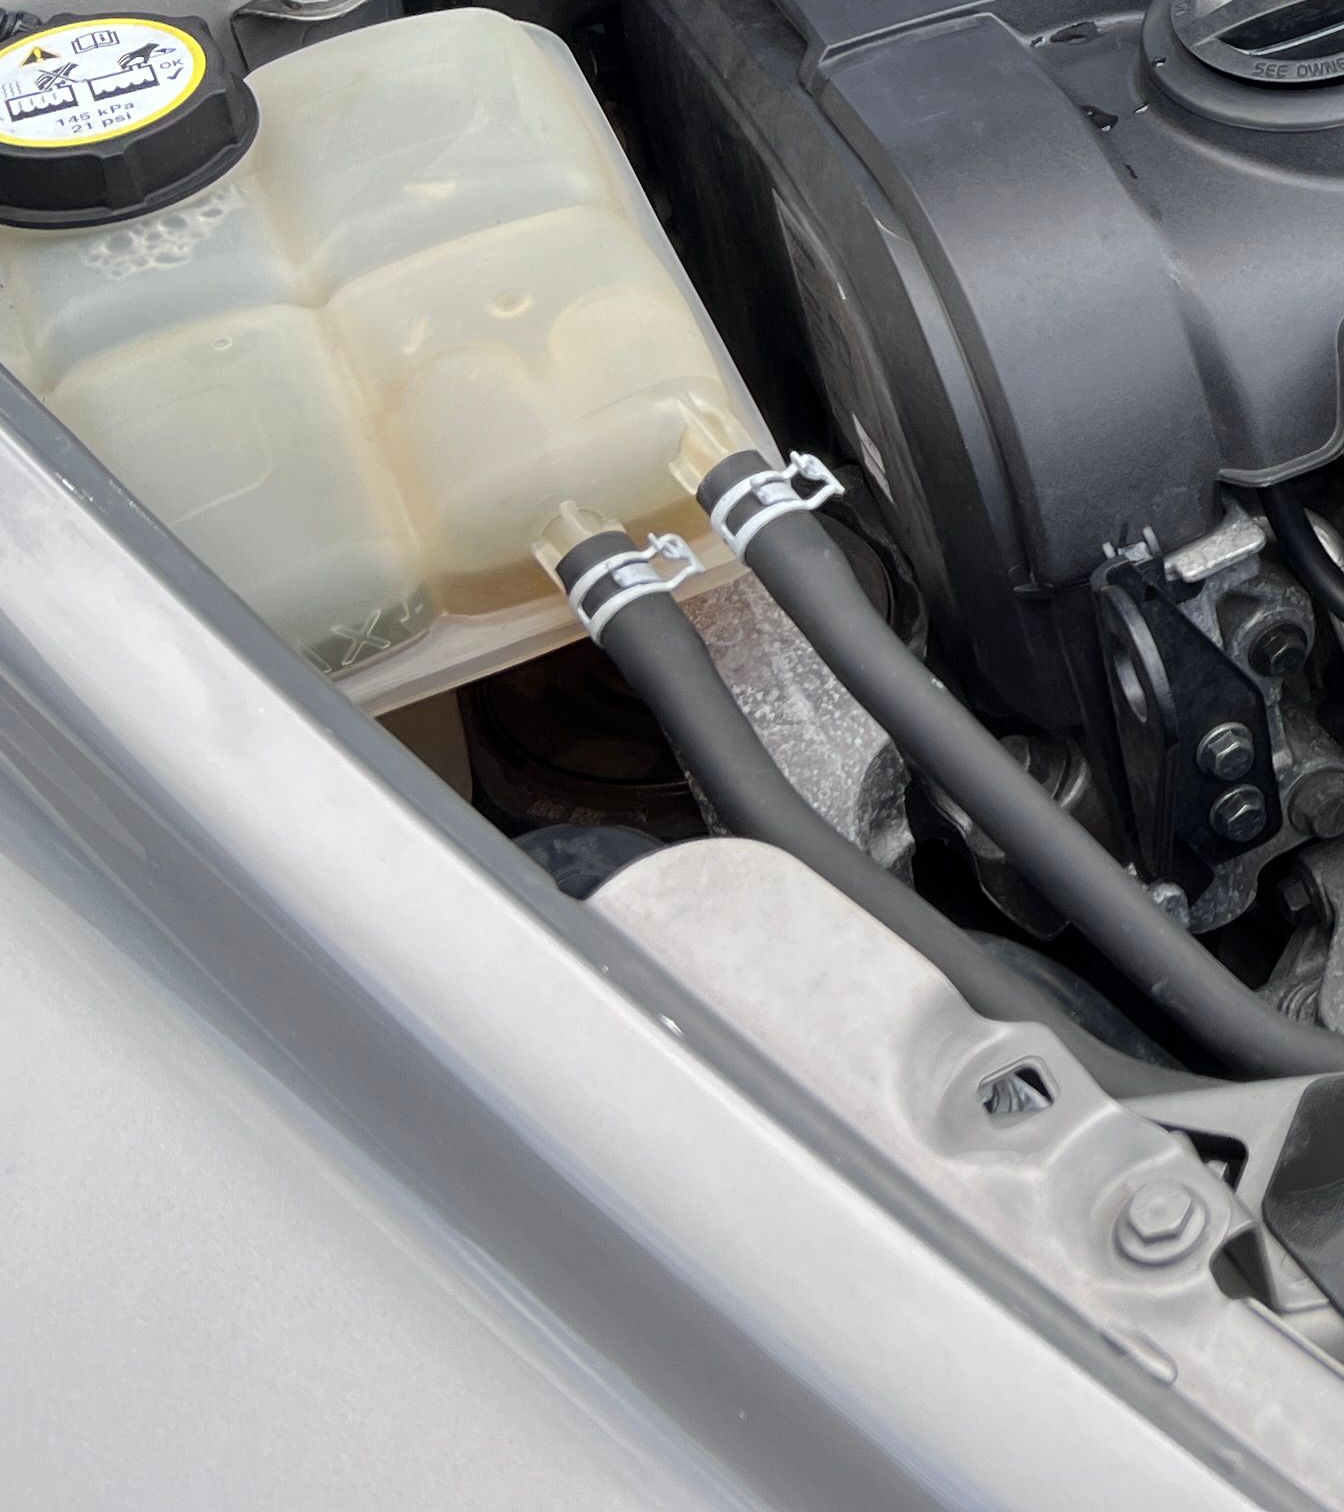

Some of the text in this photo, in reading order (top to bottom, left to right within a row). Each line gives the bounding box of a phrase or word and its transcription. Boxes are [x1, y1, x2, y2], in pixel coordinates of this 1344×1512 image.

[159, 58, 185, 70] OK
[1253, 61, 1290, 78] SEE
[97, 101, 135, 118] kPa
[70, 112, 133, 134] 21 psi
